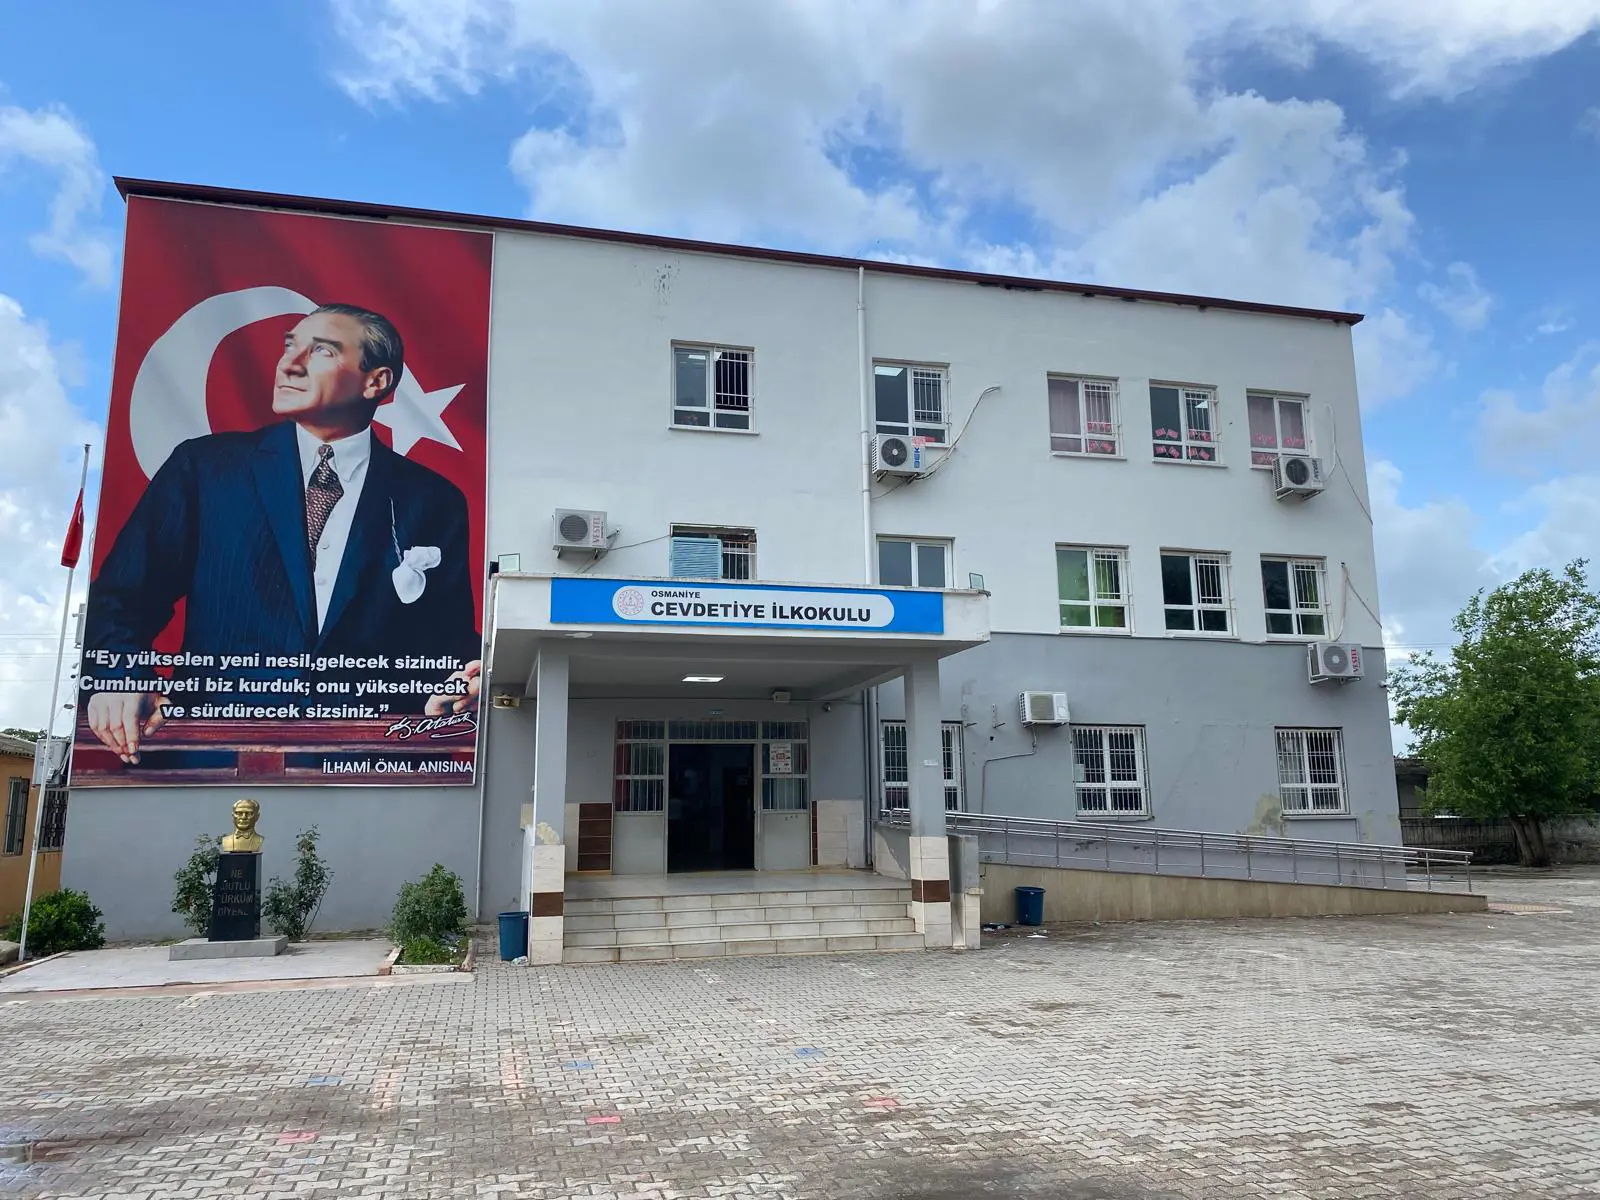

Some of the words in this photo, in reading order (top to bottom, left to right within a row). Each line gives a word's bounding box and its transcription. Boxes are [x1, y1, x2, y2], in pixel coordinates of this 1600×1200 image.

[651, 590, 700, 599] OSMANİYE
[651, 600, 765, 619] CEVDETİYE
[772, 602, 871, 622] İLKOKULU
[126, 651, 214, 668] yükselen
[219, 652, 259, 670] yeni
[394, 655, 464, 670] sizindir.
[79, 676, 199, 694] Cumhuriyeti
[205, 678, 233, 692] biz
[239, 678, 310, 696] kurduk;
[316, 681, 350, 693] onu
[355, 680, 467, 696] yükseltecek
[162, 705, 185, 718] ve
[191, 703, 300, 718] sürdürecek
[322, 758, 371, 774] İLHAMİ
[375, 758, 414, 773] ÖNAL
[417, 761, 473, 773] ANISINA
